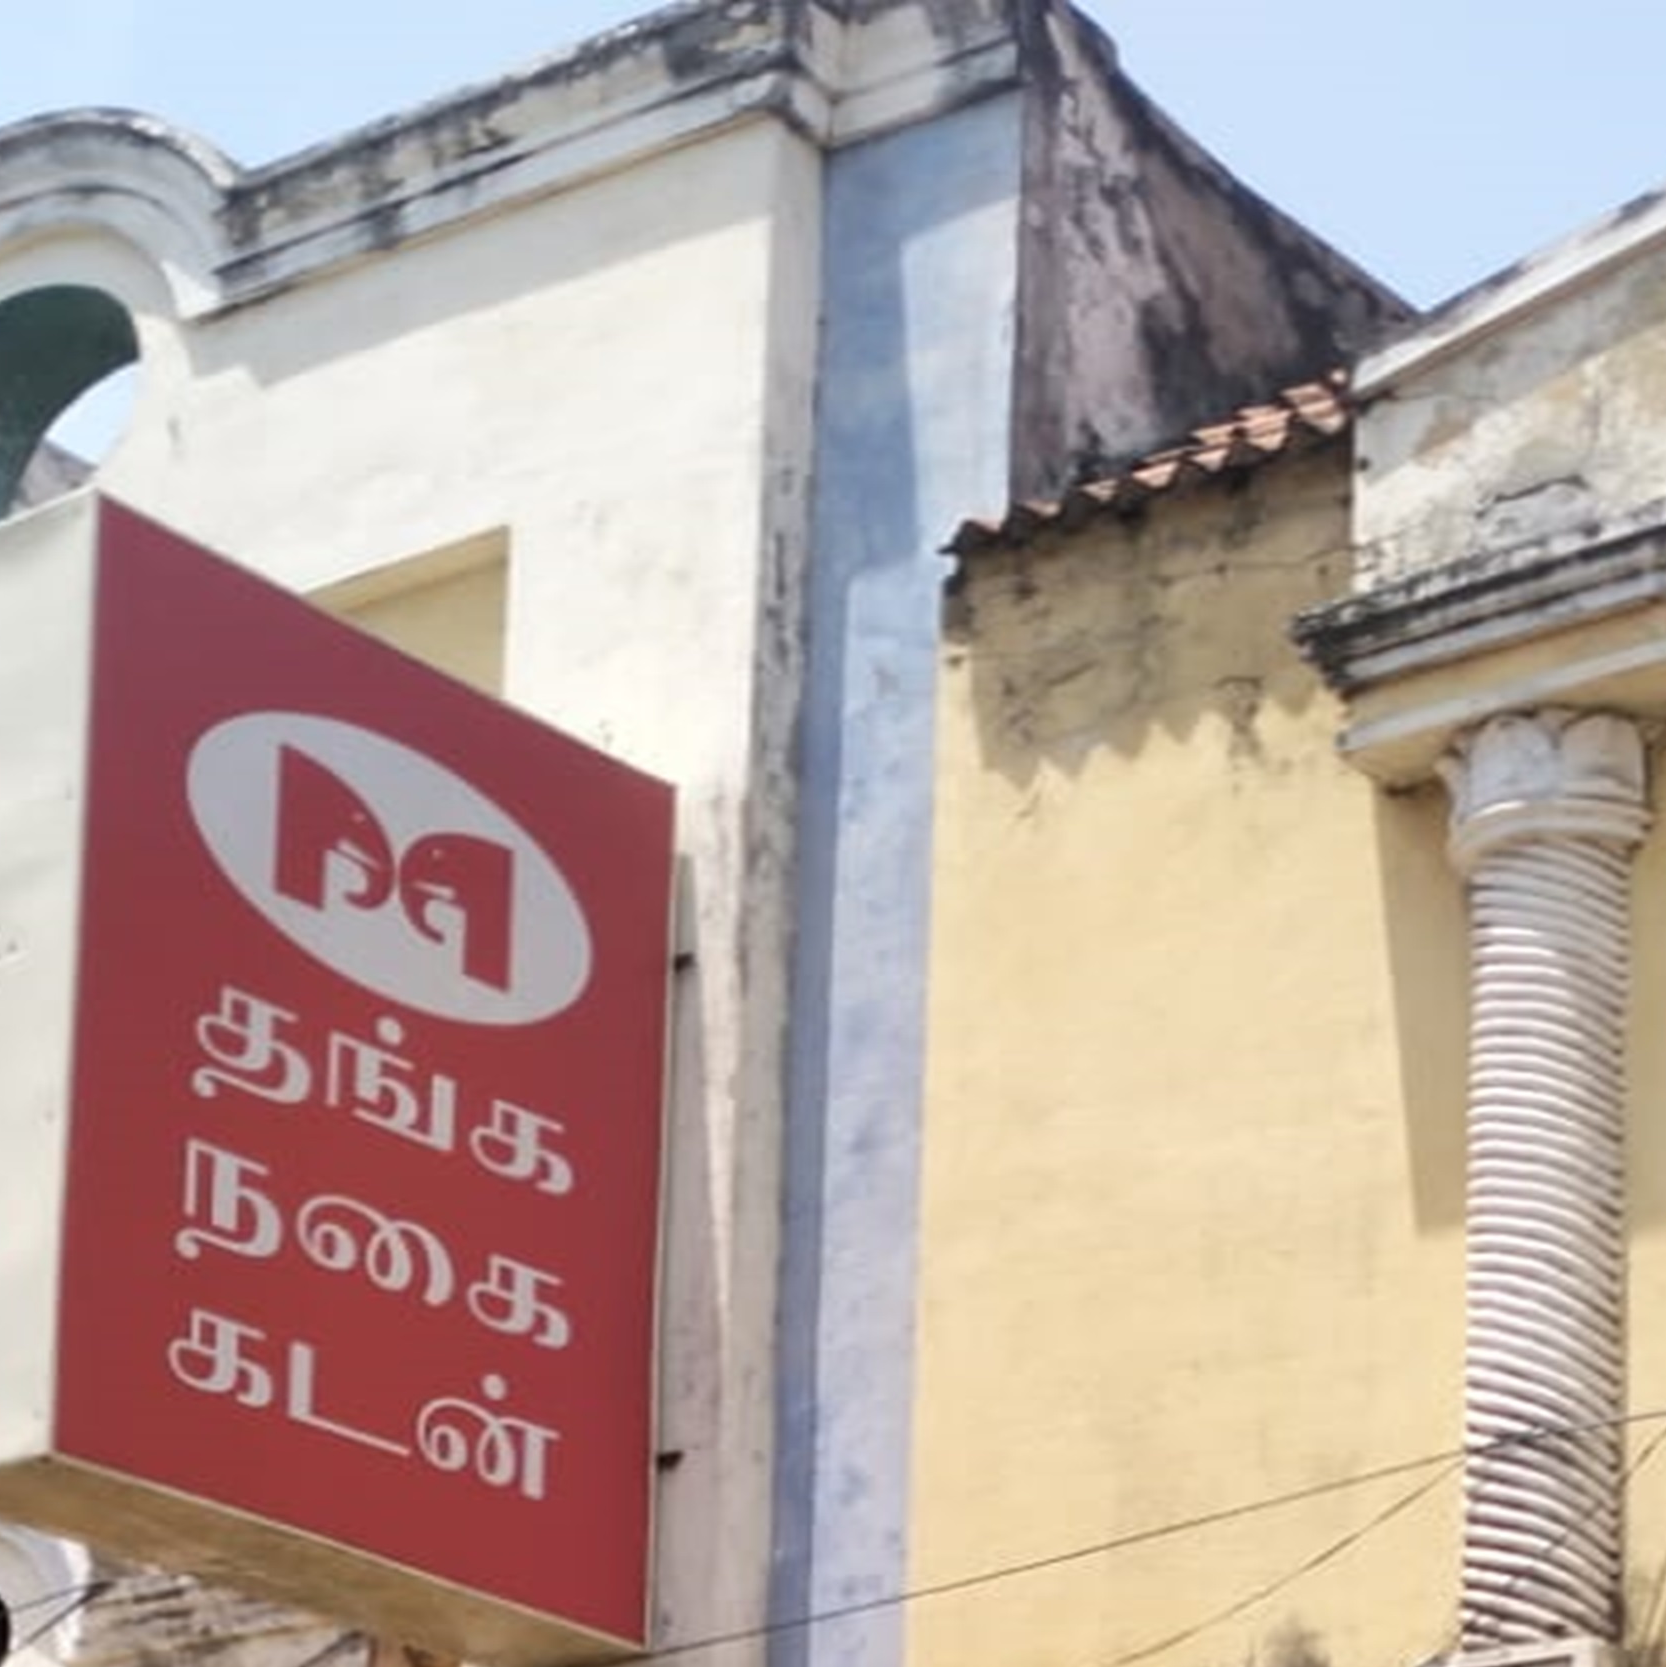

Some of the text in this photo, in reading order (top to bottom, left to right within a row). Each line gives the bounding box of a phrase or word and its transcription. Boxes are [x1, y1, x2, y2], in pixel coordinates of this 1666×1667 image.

[191, 985, 575, 1196] தங்க
[173, 1137, 574, 1350] நகை
[167, 1307, 561, 1500] கடன்
